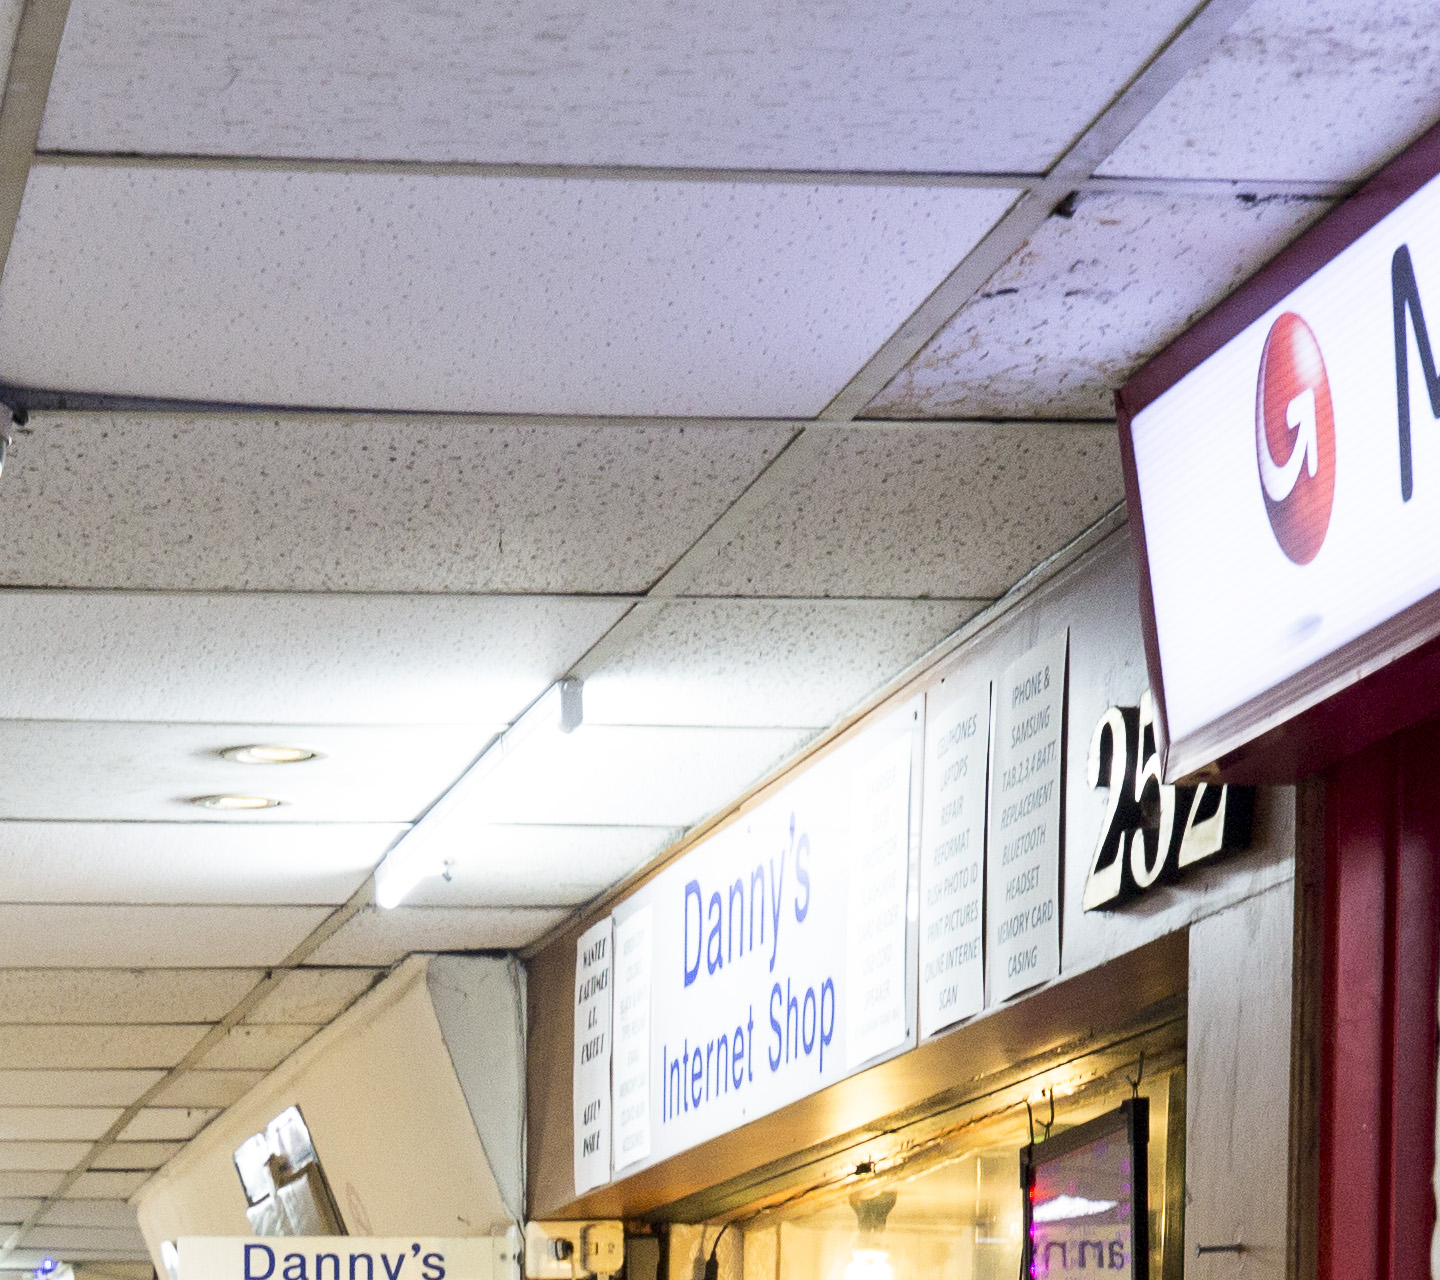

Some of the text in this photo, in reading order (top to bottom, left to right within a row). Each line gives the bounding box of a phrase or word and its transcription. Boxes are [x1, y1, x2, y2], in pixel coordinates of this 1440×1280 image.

[1011, 670, 1042, 710] IPHONE
[1011, 705, 1050, 748] SAMSUNG
[940, 755, 967, 790] LAPTOPS
[940, 794, 963, 825] REPAIR
[1000, 780, 1053, 828] REPLACEMENT
[1002, 823, 1046, 864] BLUETOOTH
[943, 866, 968, 897] PHOTO
[1005, 865, 1040, 900] HEADSET
[683, 812, 811, 989] Danny's
[944, 899, 978, 934] PICTURES
[996, 899, 1053, 943] MEMORY CARD
[1007, 945, 1037, 976] CASING
[938, 983, 957, 1008] SCAN
[661, 976, 837, 1125] Internet Shop
